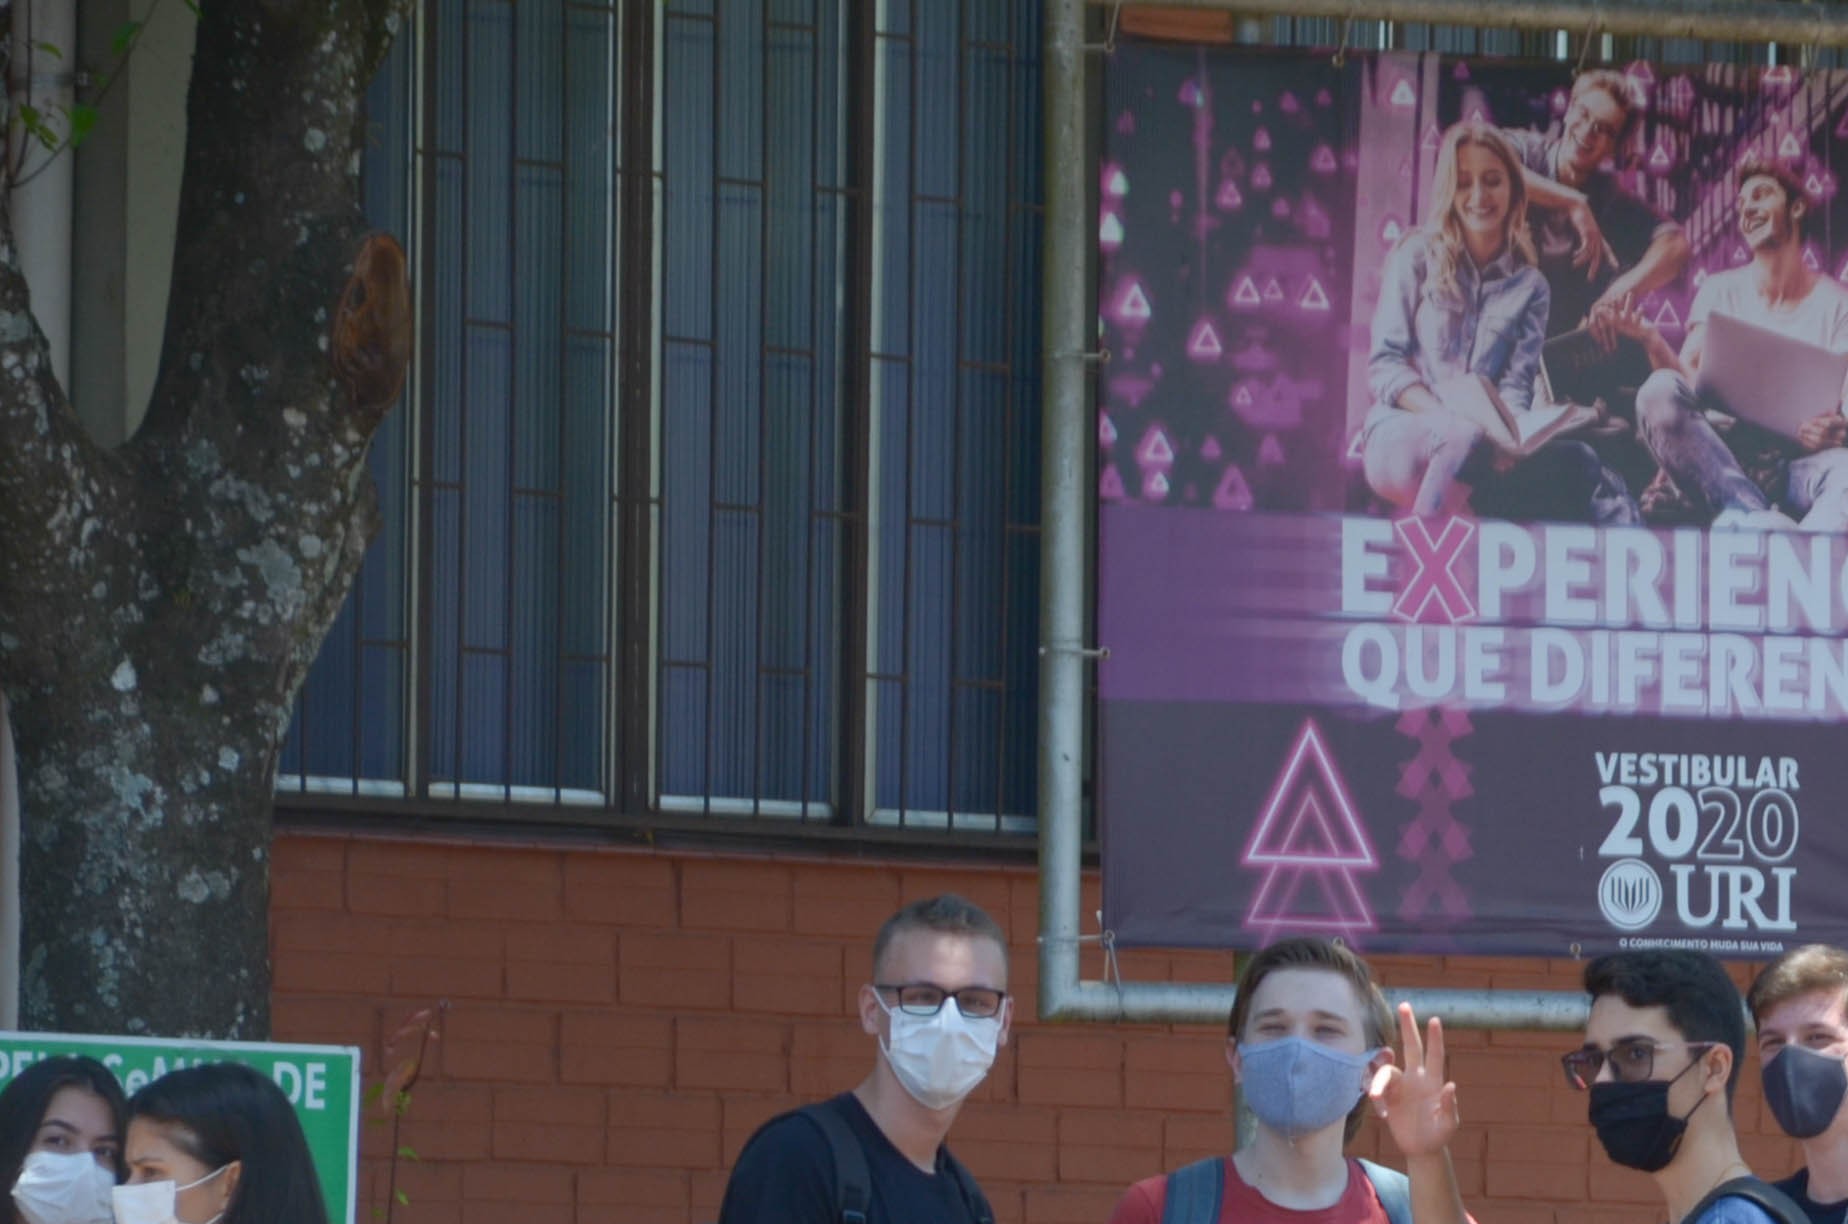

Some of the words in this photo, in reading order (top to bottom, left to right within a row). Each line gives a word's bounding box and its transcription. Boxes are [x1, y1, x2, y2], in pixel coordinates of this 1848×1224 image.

[1341, 622, 1507, 710] QUE
[1595, 752, 1800, 788] VESTIBULAR
[1598, 785, 1799, 862] 2020
[1669, 864, 1798, 930] URI
[1619, 937, 1628, 948] O
[1629, 938, 1708, 950] CONHECIMENTO
[1710, 939, 1738, 950] MUDA
[1740, 940, 1759, 951] SUA
[1760, 941, 1784, 952] VIDA
